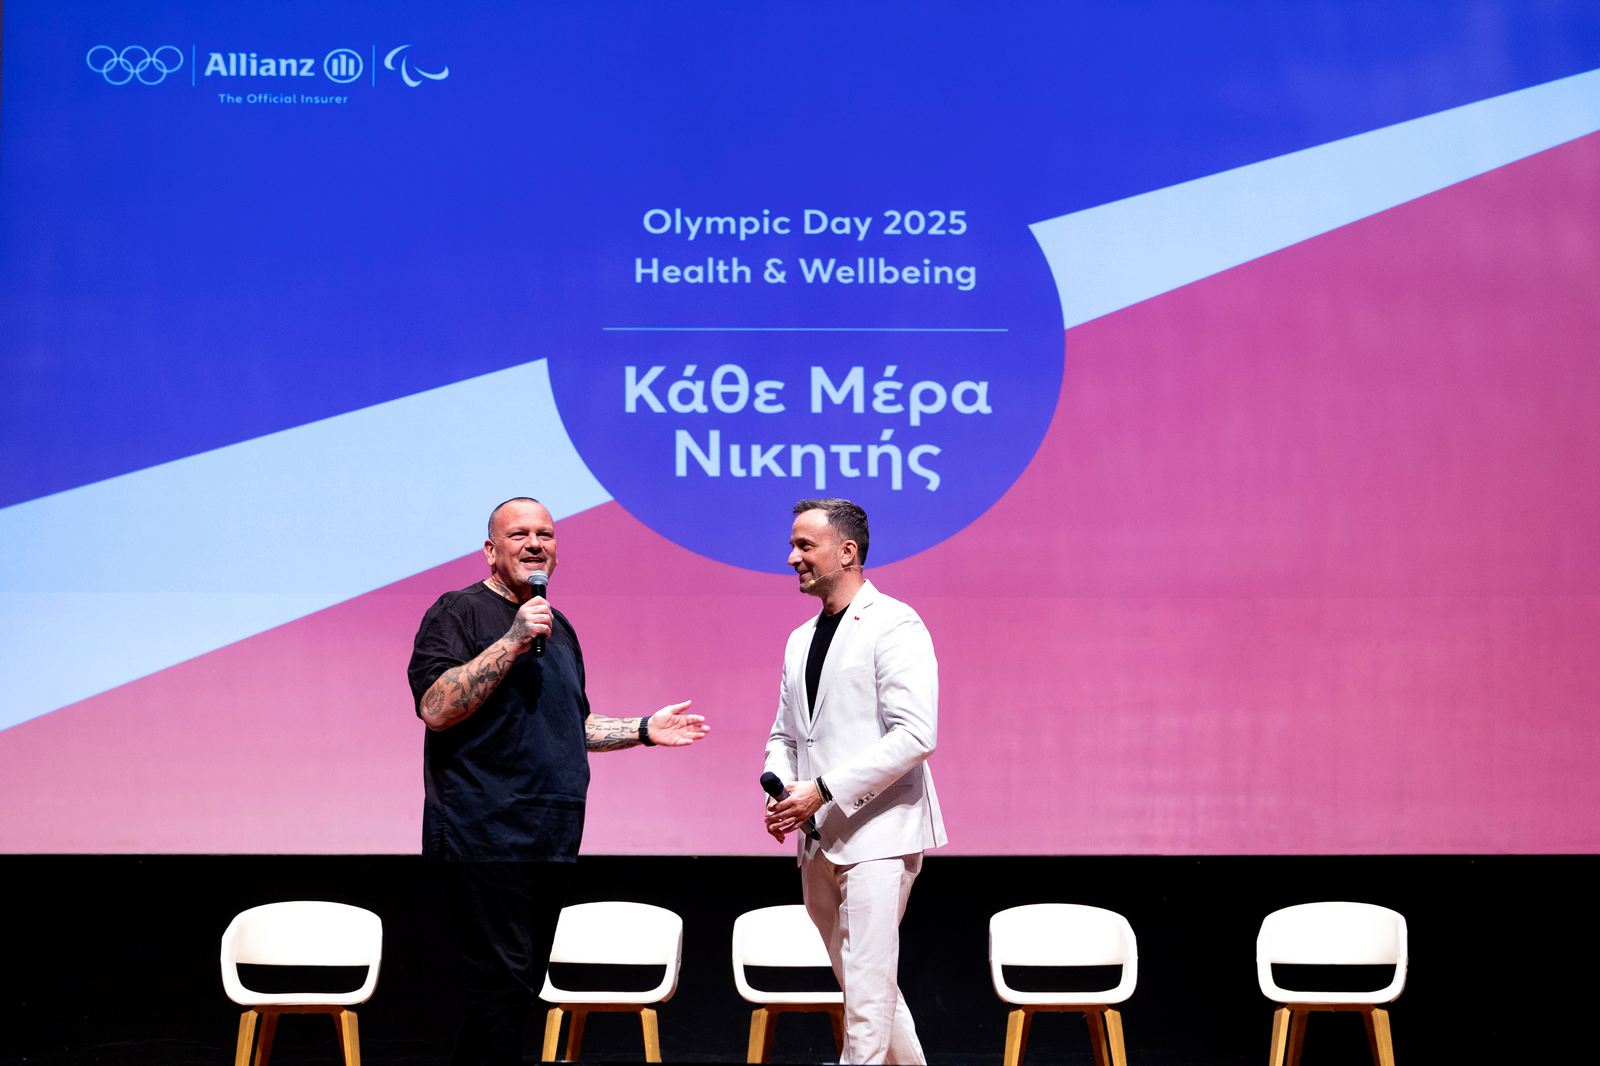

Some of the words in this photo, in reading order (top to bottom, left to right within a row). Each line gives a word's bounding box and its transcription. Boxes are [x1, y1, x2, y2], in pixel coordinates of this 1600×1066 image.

[204, 52, 316, 77] Allianz
[218, 93, 243, 104] The
[246, 93, 297, 104] Official
[300, 93, 348, 104] Insurer
[642, 207, 791, 241] Olympic
[803, 208, 873, 242] Day
[883, 209, 968, 236] 2025
[635, 256, 752, 285] Health
[763, 257, 787, 285] &
[798, 257, 976, 291] Wellbeing
[624, 363, 787, 414] Κάθε
[810, 364, 993, 427] Μέρα
[675, 428, 942, 492] Νικητής
